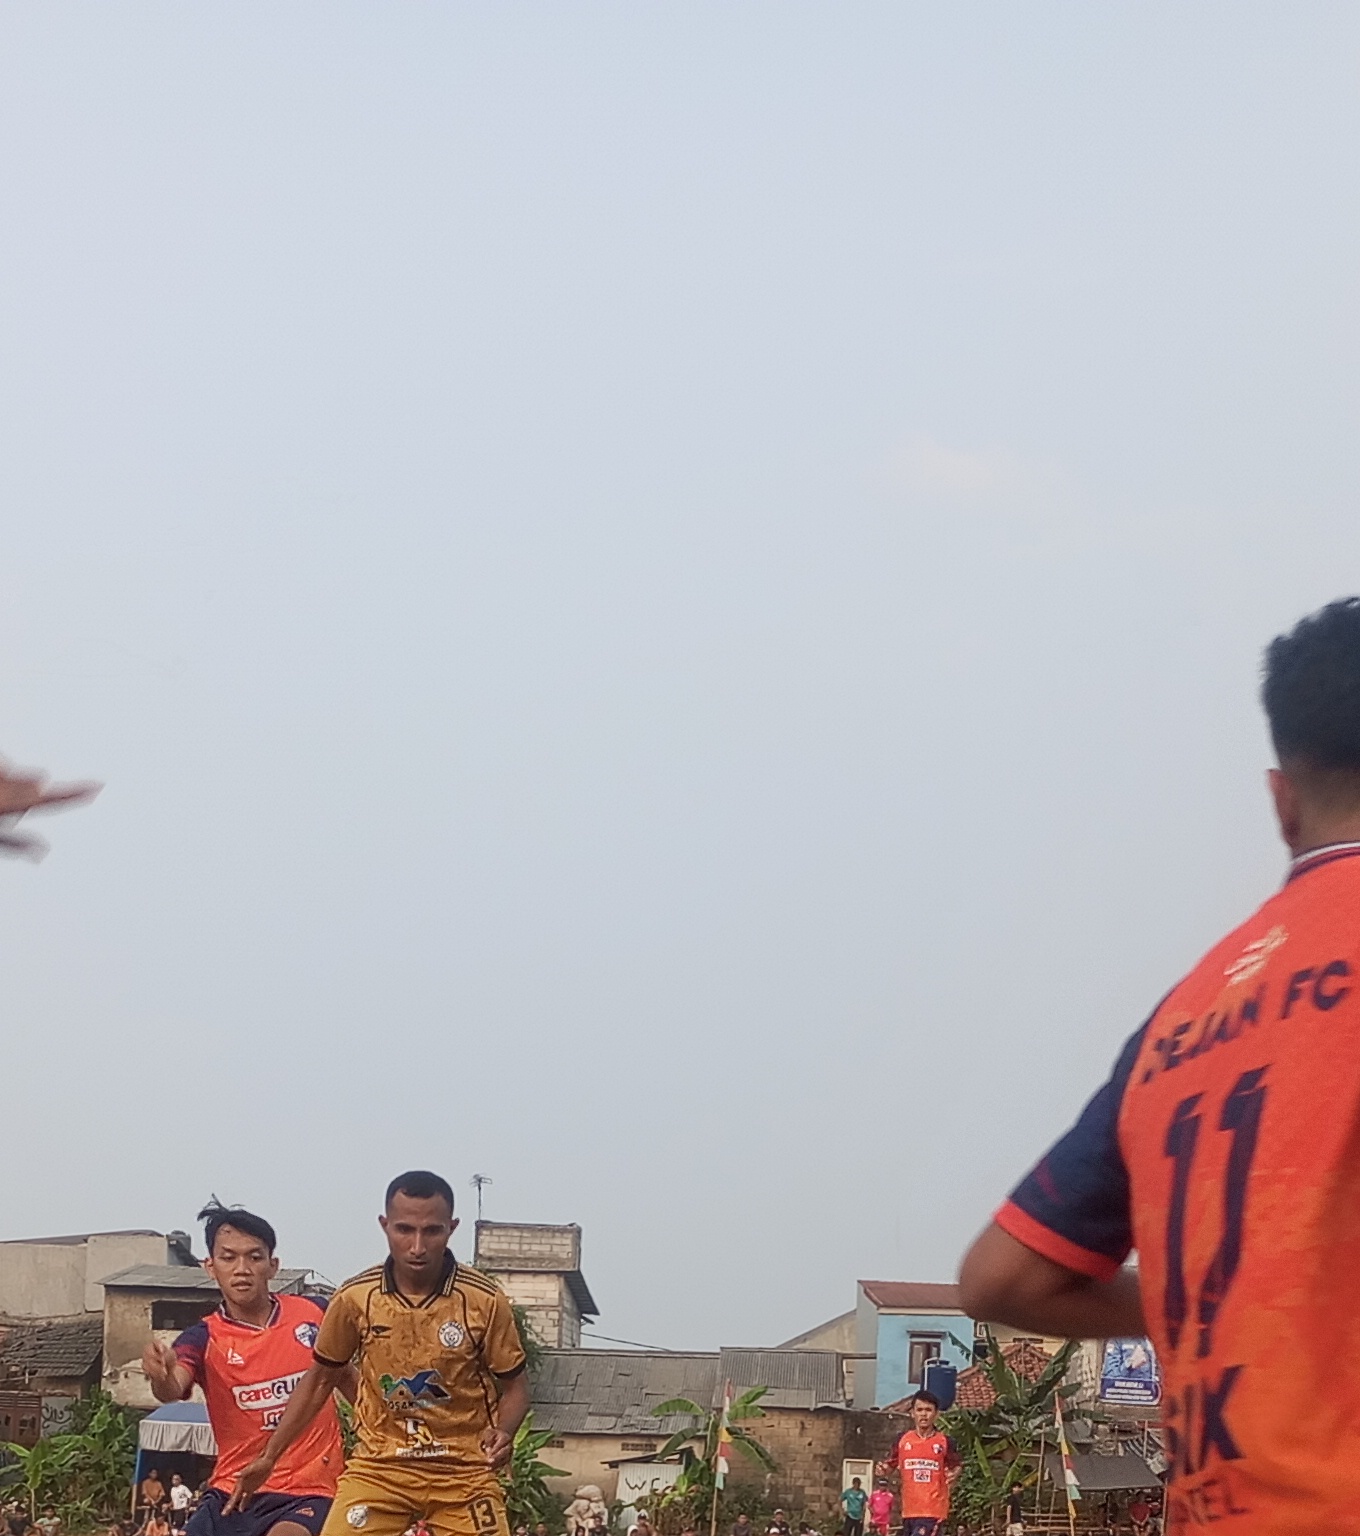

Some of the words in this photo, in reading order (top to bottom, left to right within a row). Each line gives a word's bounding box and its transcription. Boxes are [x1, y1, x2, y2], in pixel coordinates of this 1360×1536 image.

[1278, 960, 1354, 1021] FC
[1162, 1062, 1273, 1360] 11
[467, 1499, 497, 1531] 13
